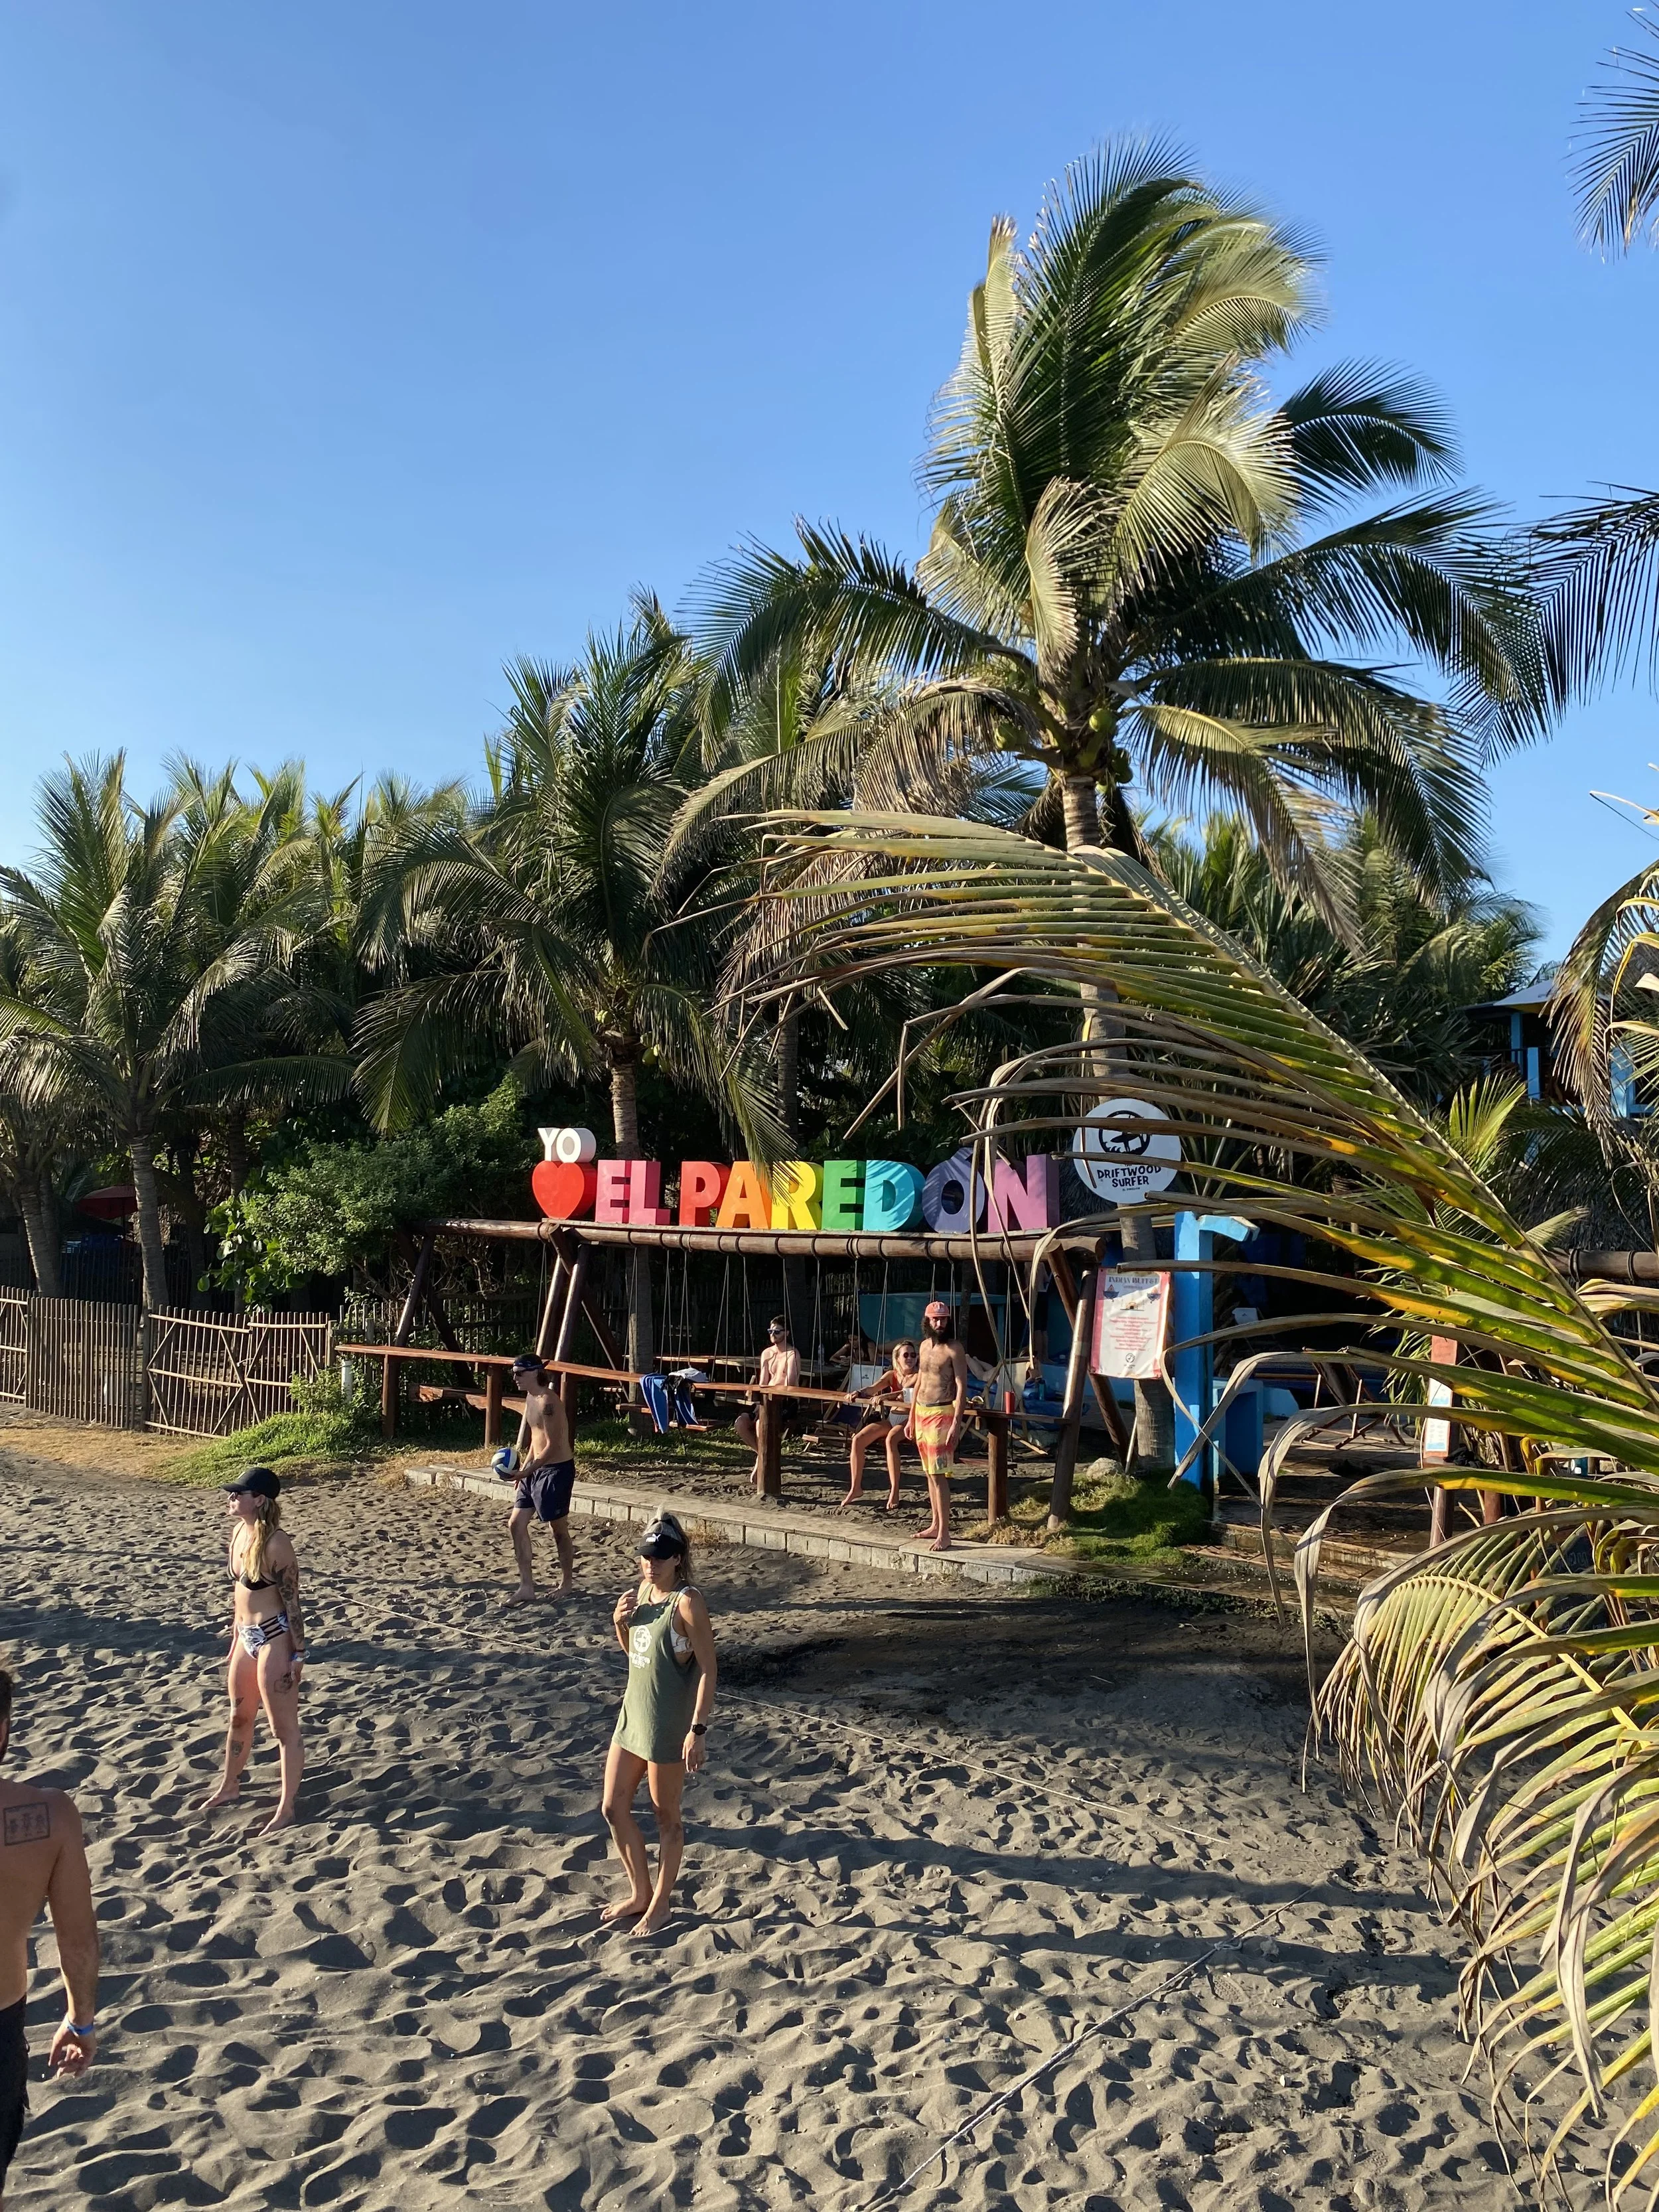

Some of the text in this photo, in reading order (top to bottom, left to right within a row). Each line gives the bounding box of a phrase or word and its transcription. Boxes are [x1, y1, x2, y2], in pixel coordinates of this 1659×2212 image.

[538, 1128, 595, 1163] YO
[1096, 1165, 1162, 1179] DRIFTWOOD
[1112, 1175, 1149, 1188] SURFER
[595, 1159, 670, 1224] EL
